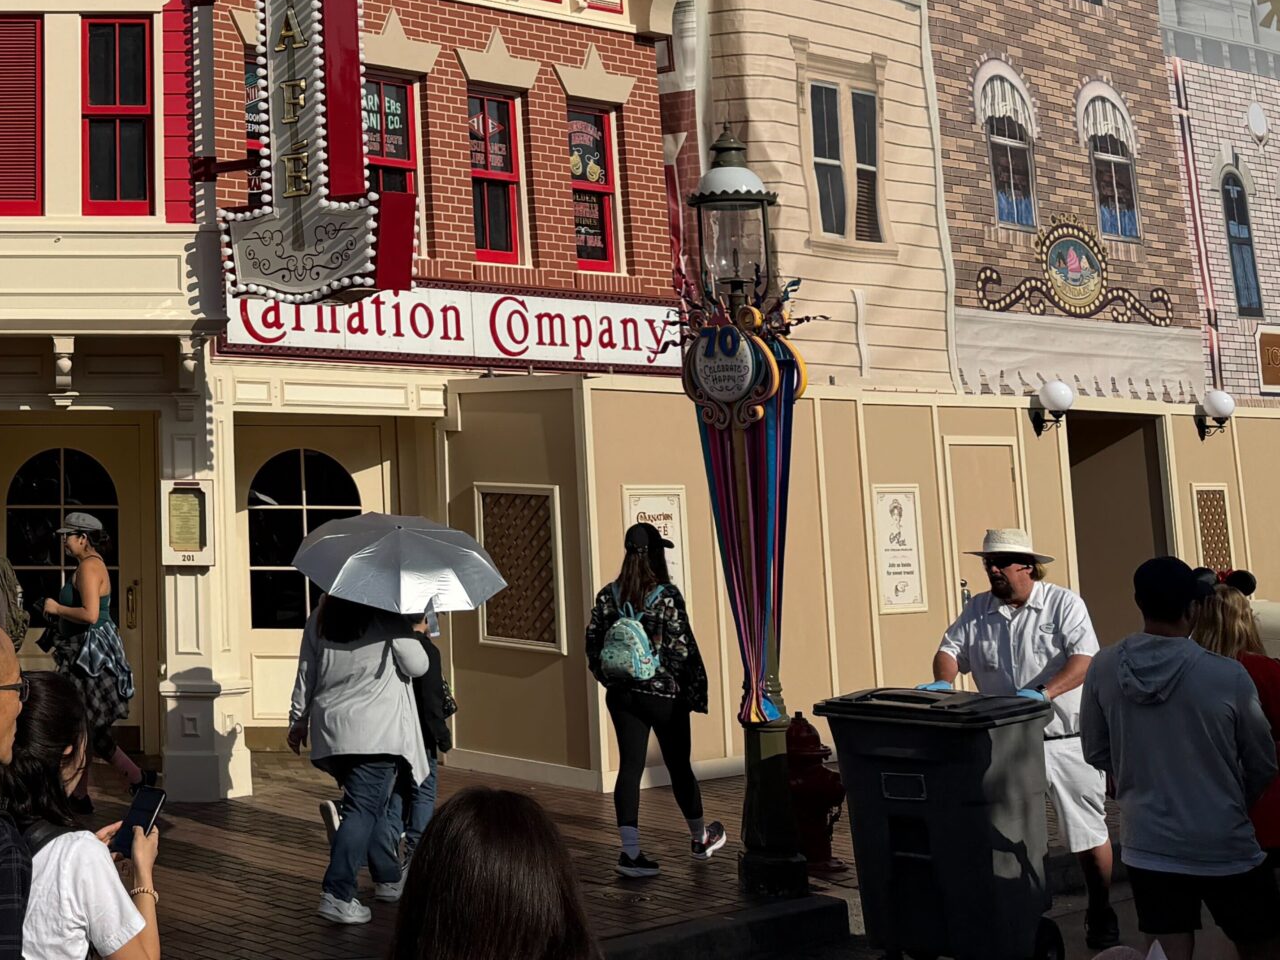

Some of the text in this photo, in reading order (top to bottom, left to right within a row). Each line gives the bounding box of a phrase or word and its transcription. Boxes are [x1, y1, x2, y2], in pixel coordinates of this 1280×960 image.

[387, 115, 403, 130] CO.
[489, 296, 670, 364] Company
[701, 324, 740, 358] 70
[181, 554, 195, 562] 201
